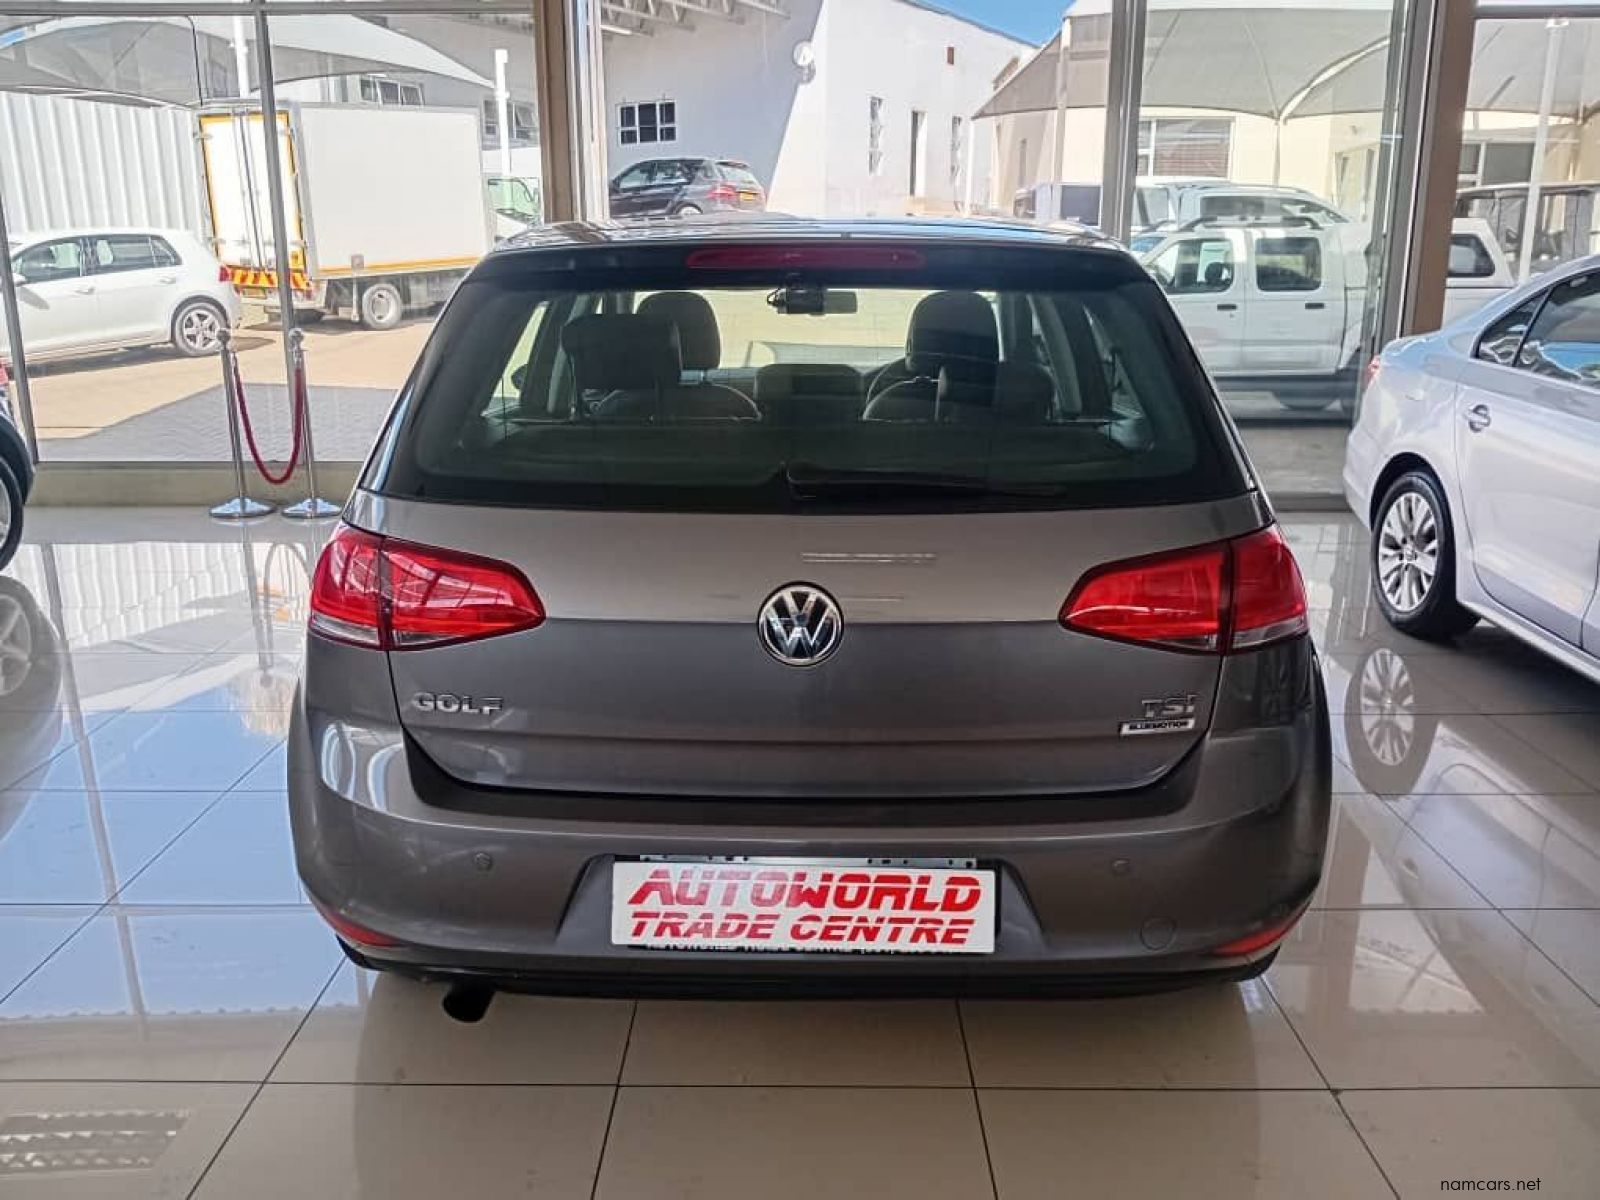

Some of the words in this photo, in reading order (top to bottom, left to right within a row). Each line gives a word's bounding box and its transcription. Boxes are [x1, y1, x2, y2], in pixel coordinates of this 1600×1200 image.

[412, 692, 503, 715] GOLF
[627, 868, 982, 913] AUTOWORLD
[630, 912, 780, 941] TRADE
[789, 915, 975, 945] CENTRE
